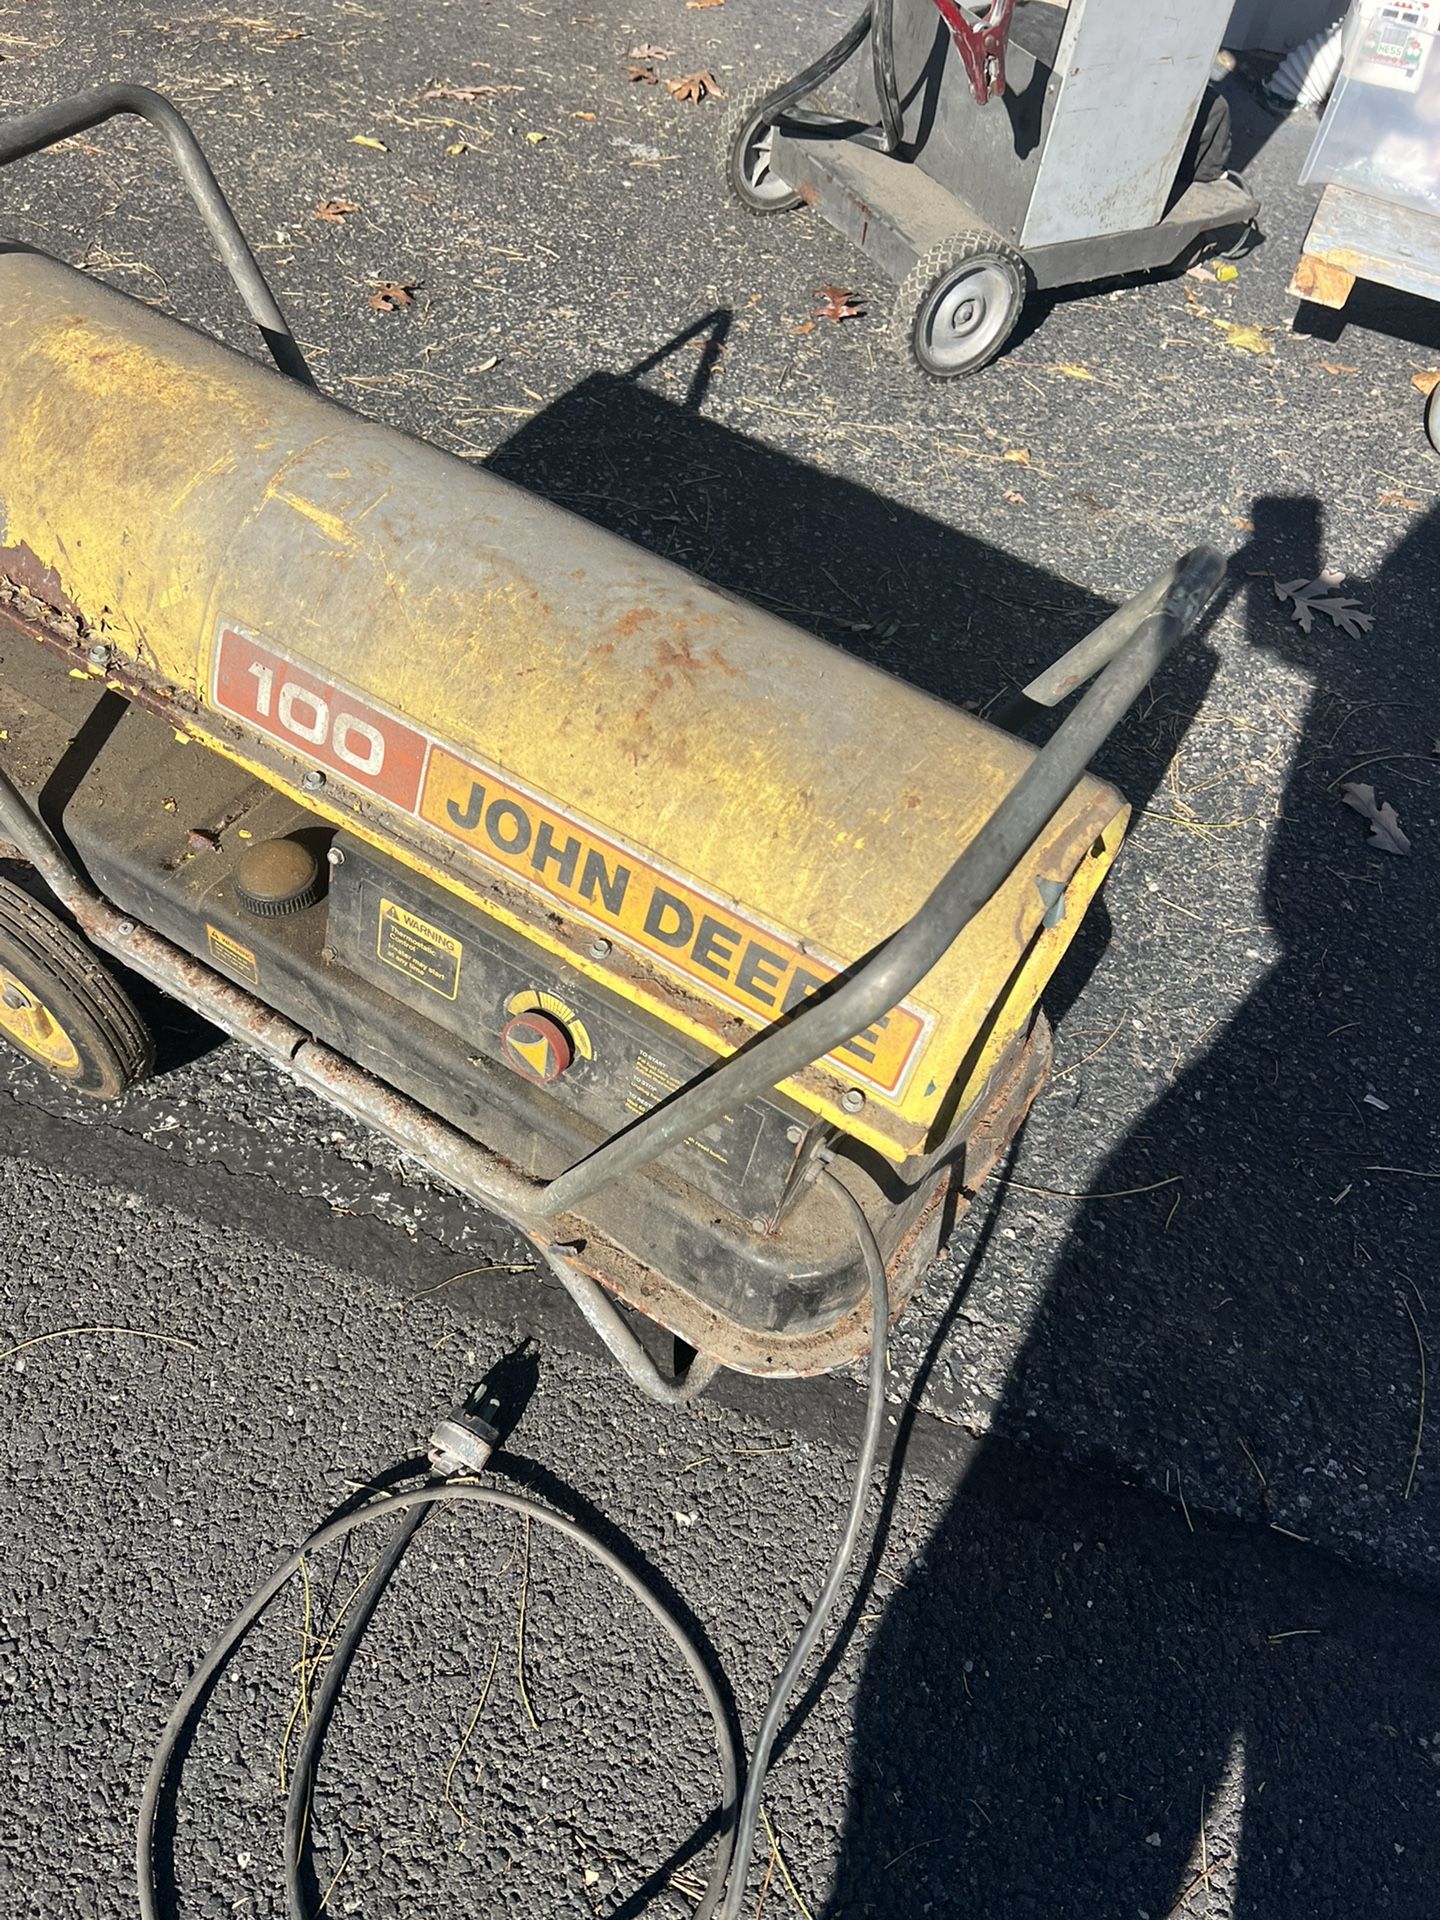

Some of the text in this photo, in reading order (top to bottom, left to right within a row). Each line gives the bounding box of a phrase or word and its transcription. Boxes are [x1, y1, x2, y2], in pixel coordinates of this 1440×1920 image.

[248, 661, 385, 776] 100
[447, 782, 631, 916] JOHN
[390, 925, 437, 957] Thermostatic
[403, 915, 455, 951] WARNING
[387, 942, 412, 960] Heater
[639, 1049, 667, 1069] TO START
[632, 1075, 641, 1083] TO
